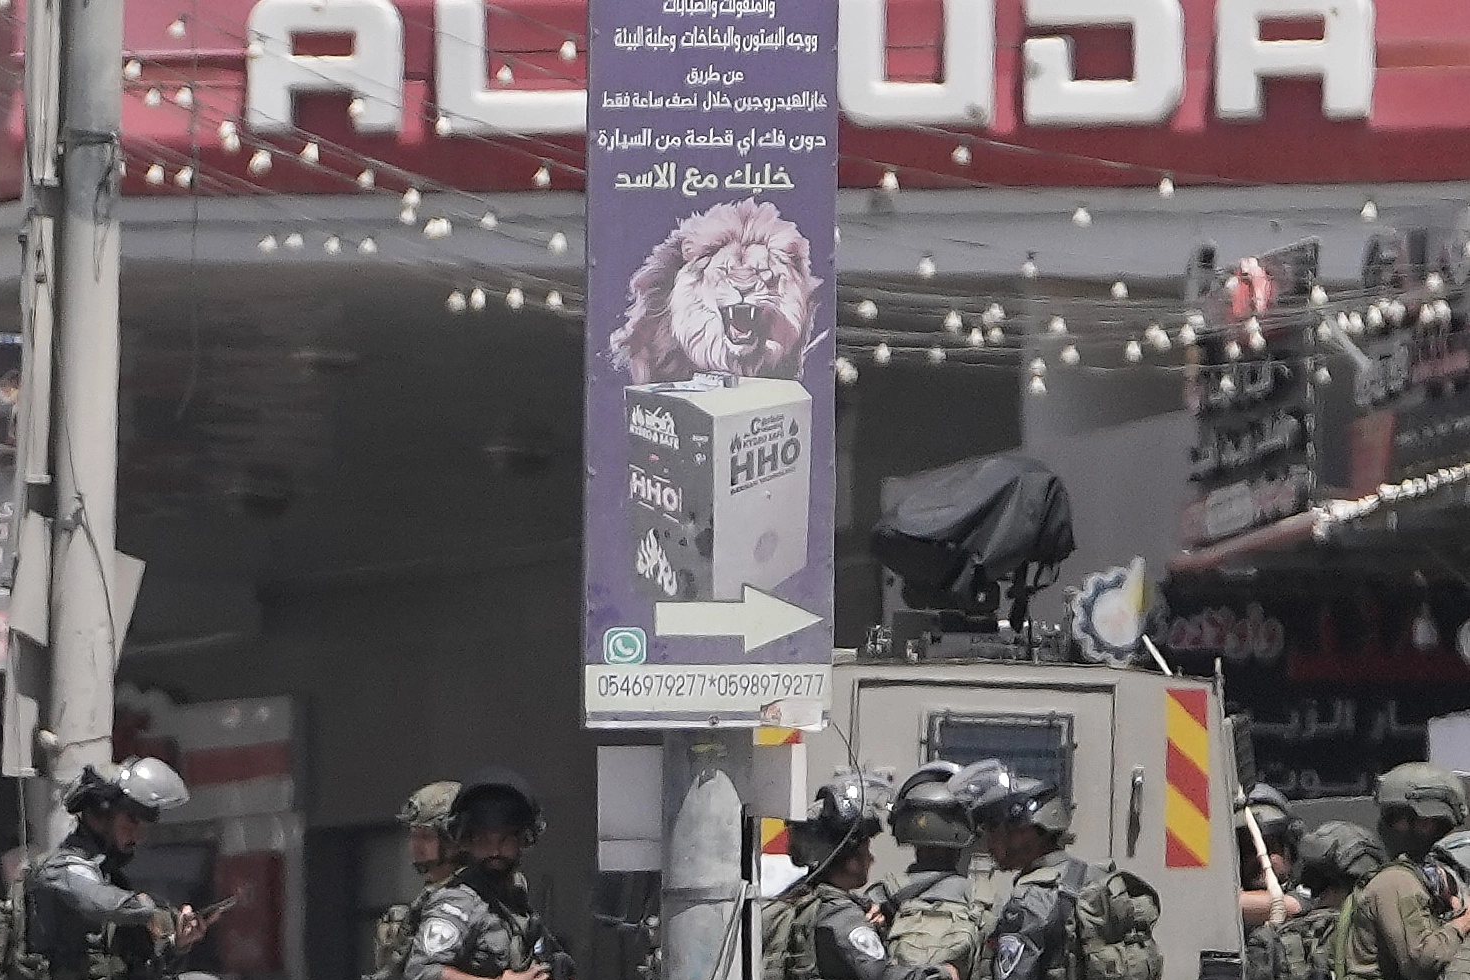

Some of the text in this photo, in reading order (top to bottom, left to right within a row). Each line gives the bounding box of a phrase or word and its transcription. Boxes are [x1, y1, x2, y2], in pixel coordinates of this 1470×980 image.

[248, 0, 1376, 135] ALUDA
[686, 64, 744, 85] عن طريق
[602, 90, 630, 108] فقط
[632, 91, 663, 108] ساعة
[665, 92, 698, 108] نصف
[702, 90, 732, 111] خلال
[597, 127, 652, 151] السيارة
[655, 133, 681, 150] من
[684, 127, 734, 149] قطعة
[758, 128, 786, 148] فك
[789, 132, 827, 151] دون
[614, 161, 795, 196] خليك مع الاسد
[730, 437, 802, 487] HHO
